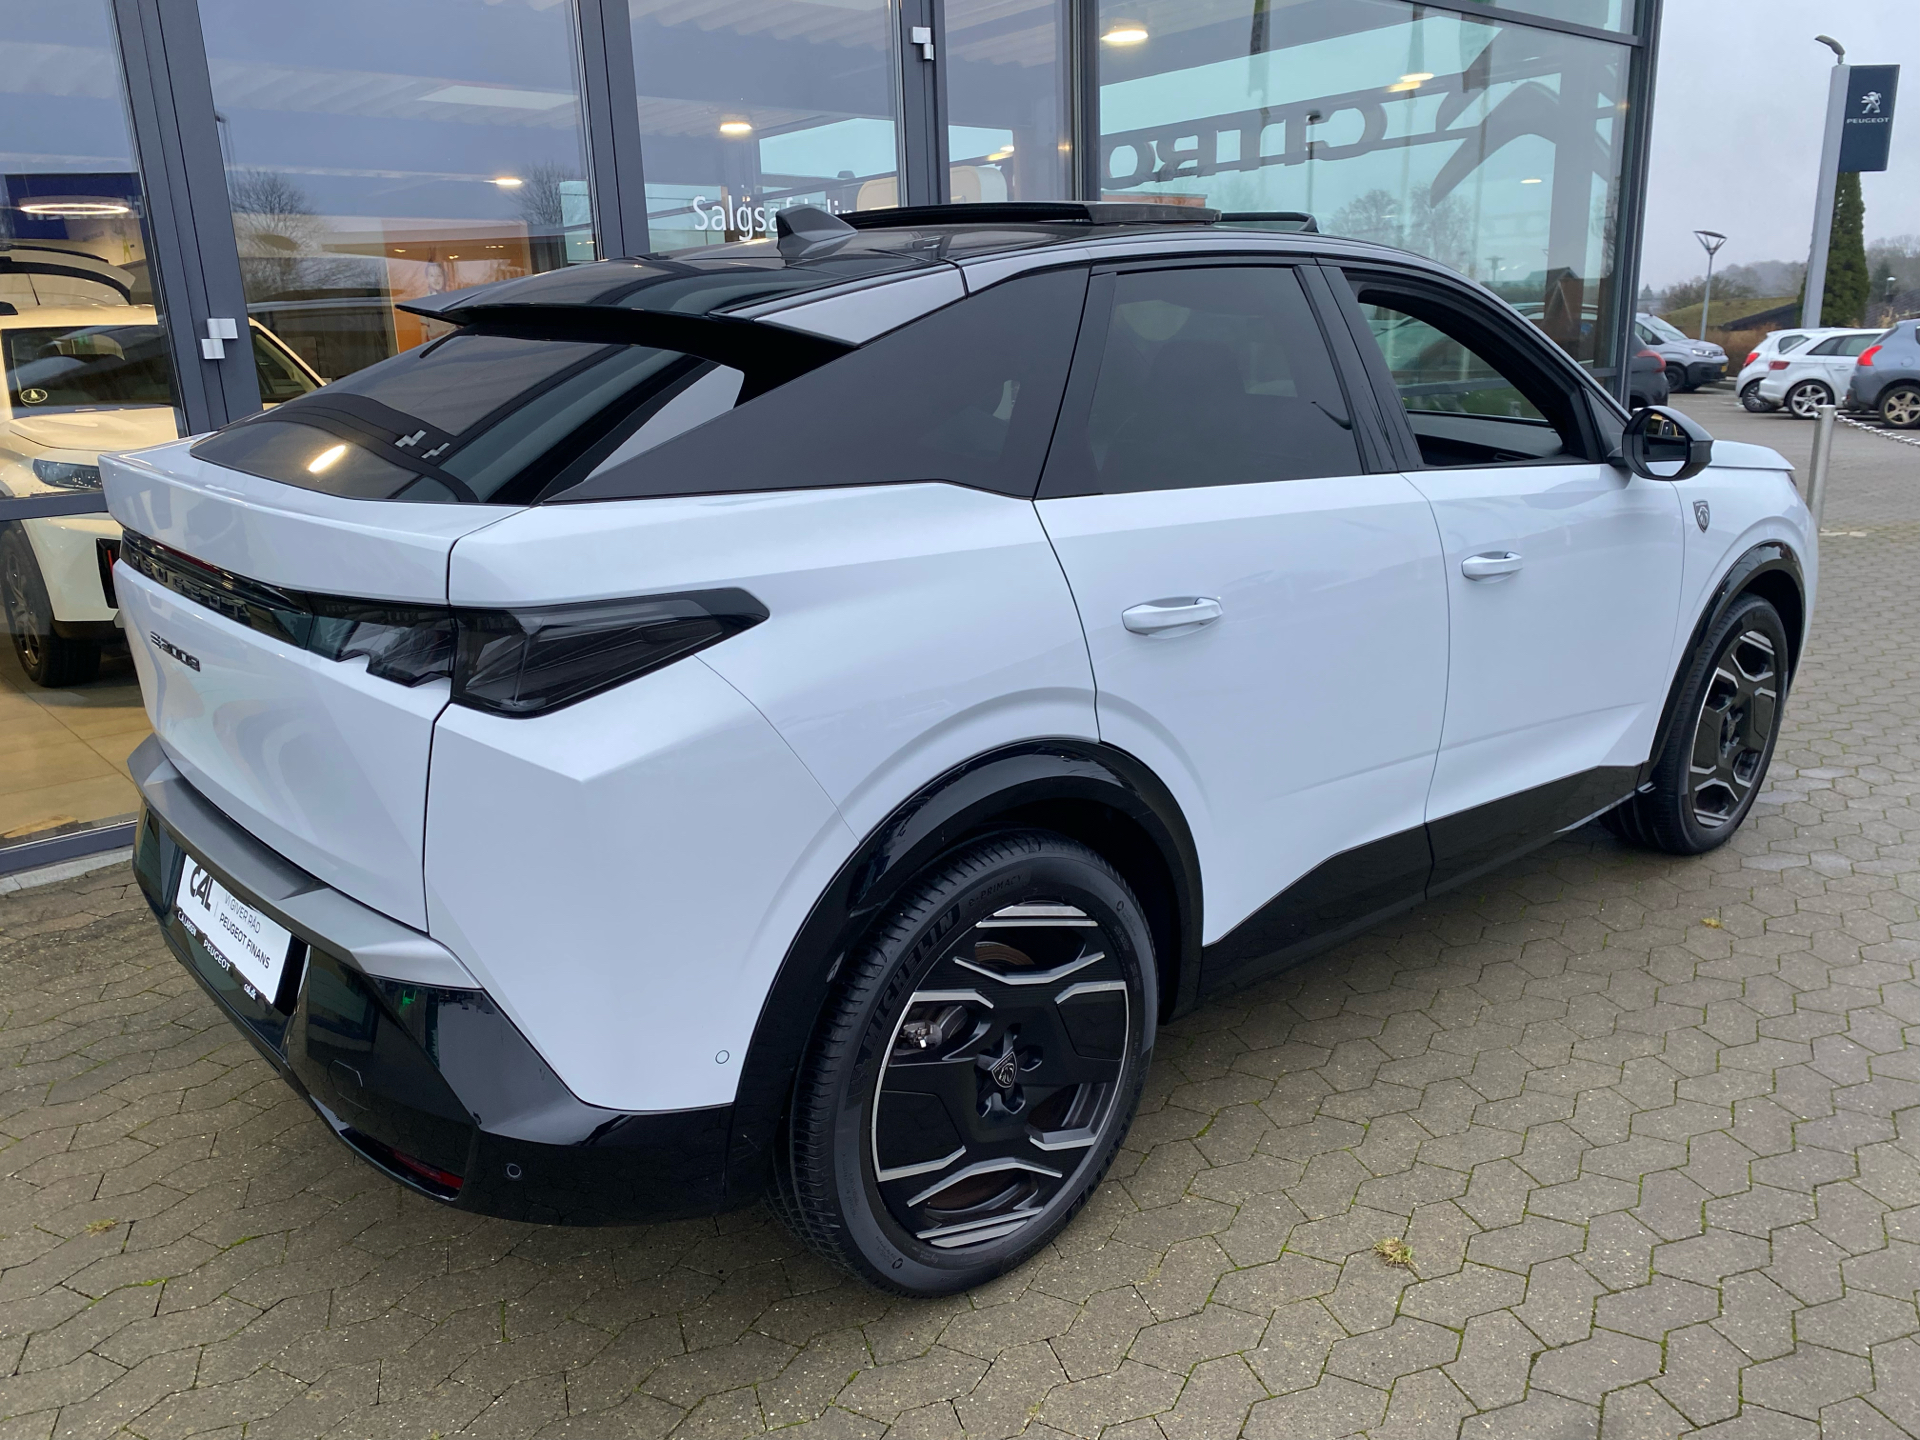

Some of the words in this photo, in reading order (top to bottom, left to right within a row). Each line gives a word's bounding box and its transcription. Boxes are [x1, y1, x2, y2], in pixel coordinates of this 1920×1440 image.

[130, 549, 250, 622] PEUGEOT
[230, 898, 248, 922] GIVER
[203, 939, 230, 971] PEUGEOT
[219, 912, 247, 945] PEUGEOT
[246, 939, 271, 969] FINANS
[861, 907, 958, 1056] MICHELIN
